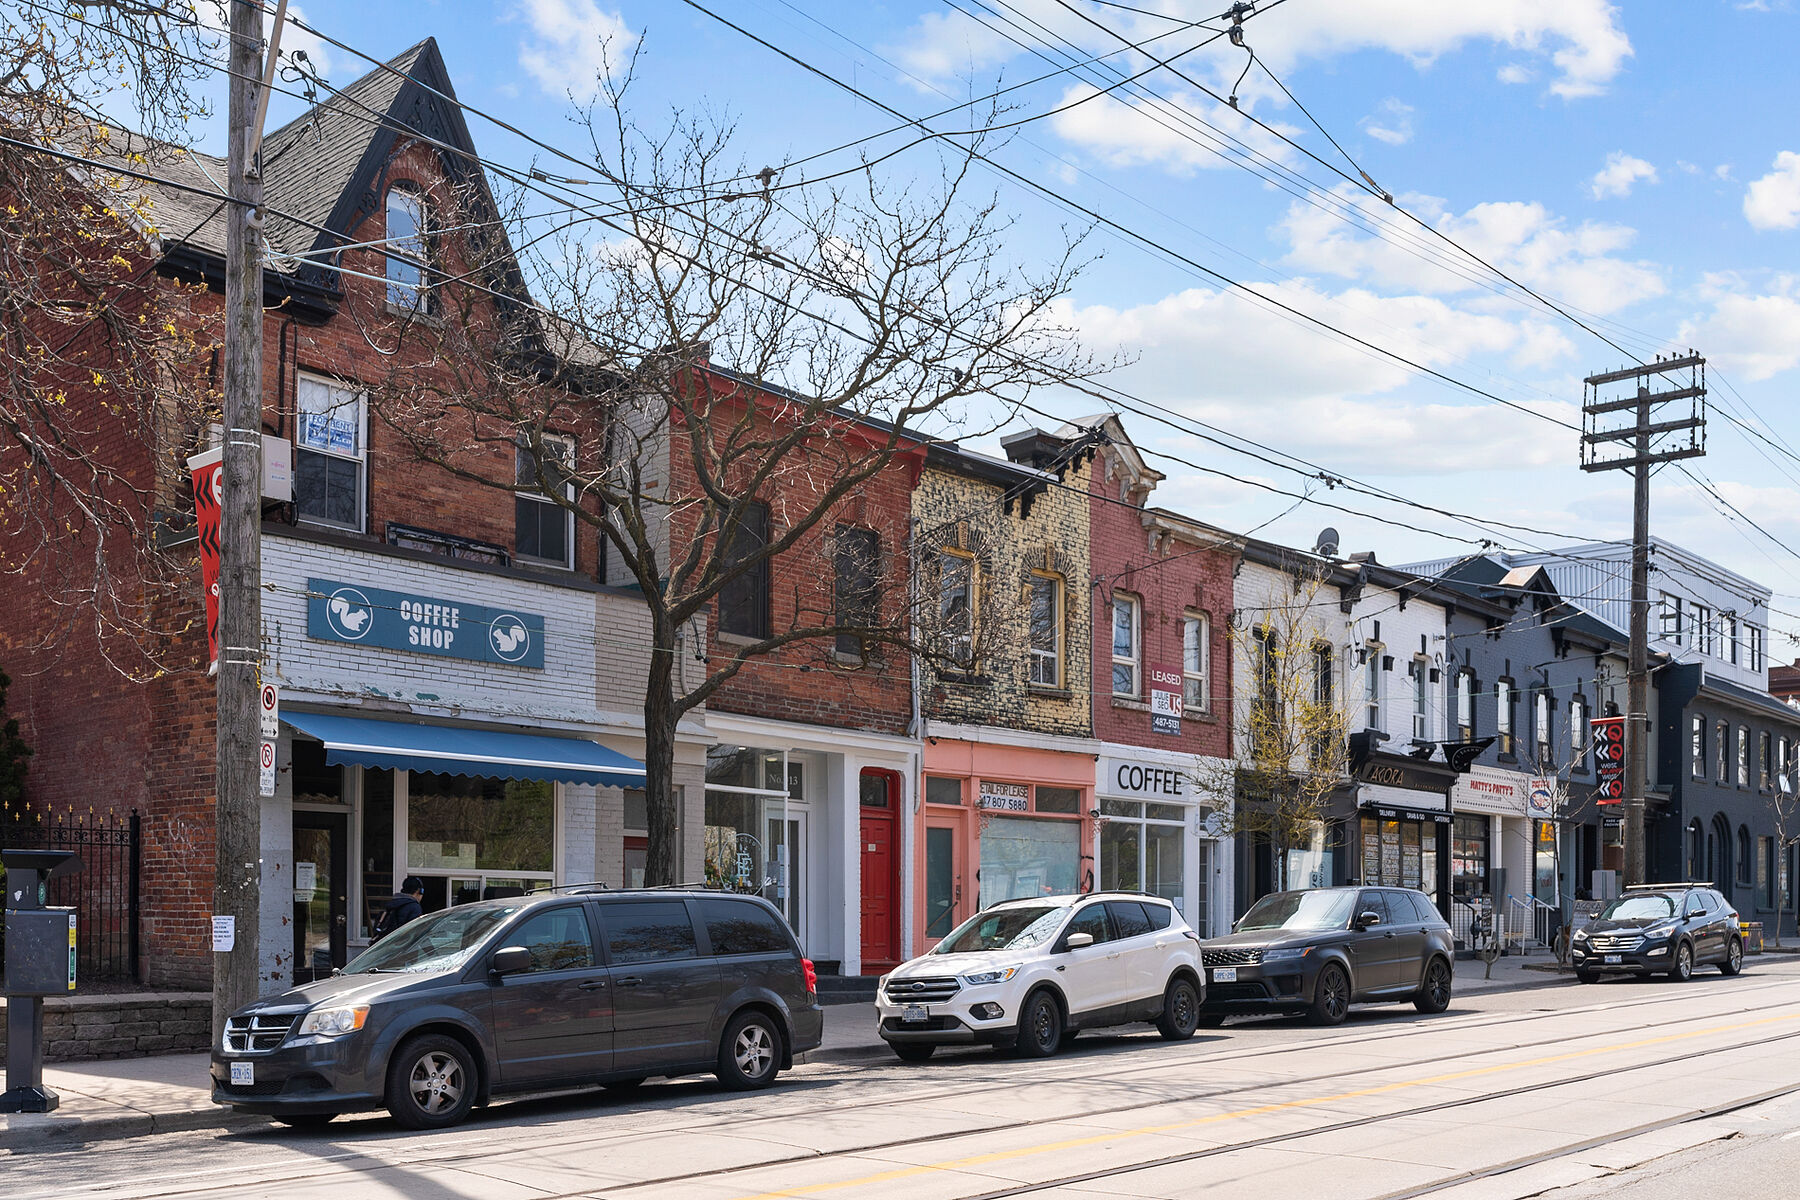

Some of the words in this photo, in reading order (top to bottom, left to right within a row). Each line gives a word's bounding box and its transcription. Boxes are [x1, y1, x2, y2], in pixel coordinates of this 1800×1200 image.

[400, 600, 459, 628] COFFEE
[409, 625, 454, 649] SHOP
[1152, 669, 1181, 686] LEASED
[1154, 691, 1169, 702] JULIE
[1157, 700, 1169, 711] SEO
[789, 776, 798, 785] 13
[1117, 764, 1183, 796] COFFEE
[1370, 766, 1405, 785] AGORA
[997, 785, 1008, 796] FOR
[1009, 786, 1028, 798] LEASE
[1470, 780, 1492, 792] MATTY'S
[1492, 783, 1513, 796] PATTY'S
[992, 797, 1006, 809] 807
[1008, 799, 1027, 811] 5880
[1379, 809, 1396, 817] DELIVERY
